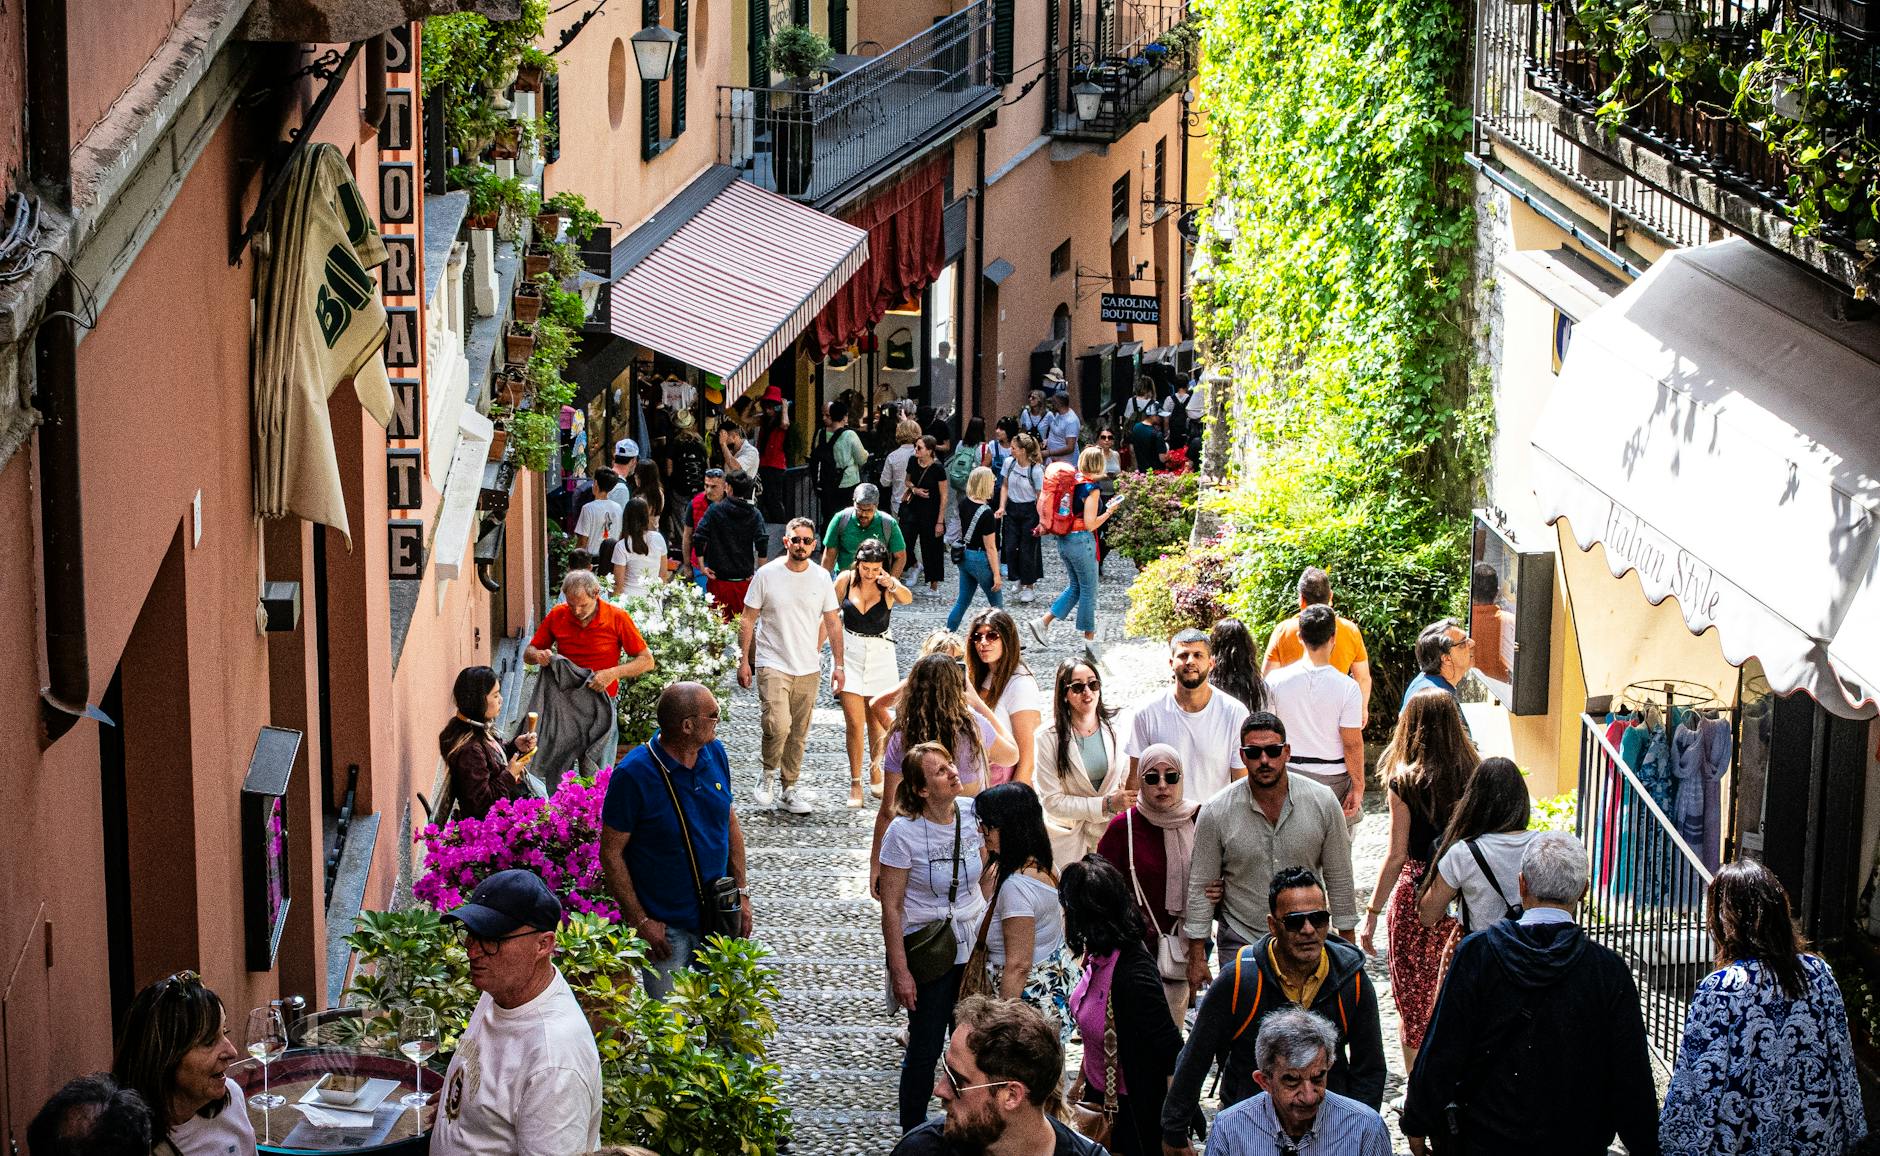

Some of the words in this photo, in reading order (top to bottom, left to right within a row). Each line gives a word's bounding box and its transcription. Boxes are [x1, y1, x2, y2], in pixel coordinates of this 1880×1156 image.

[1101, 296, 1159, 310] CAROLINA
[1102, 308, 1159, 323] BOUTIQUE
[1604, 500, 1665, 583] Italian
[1670, 548, 1720, 623] Style
